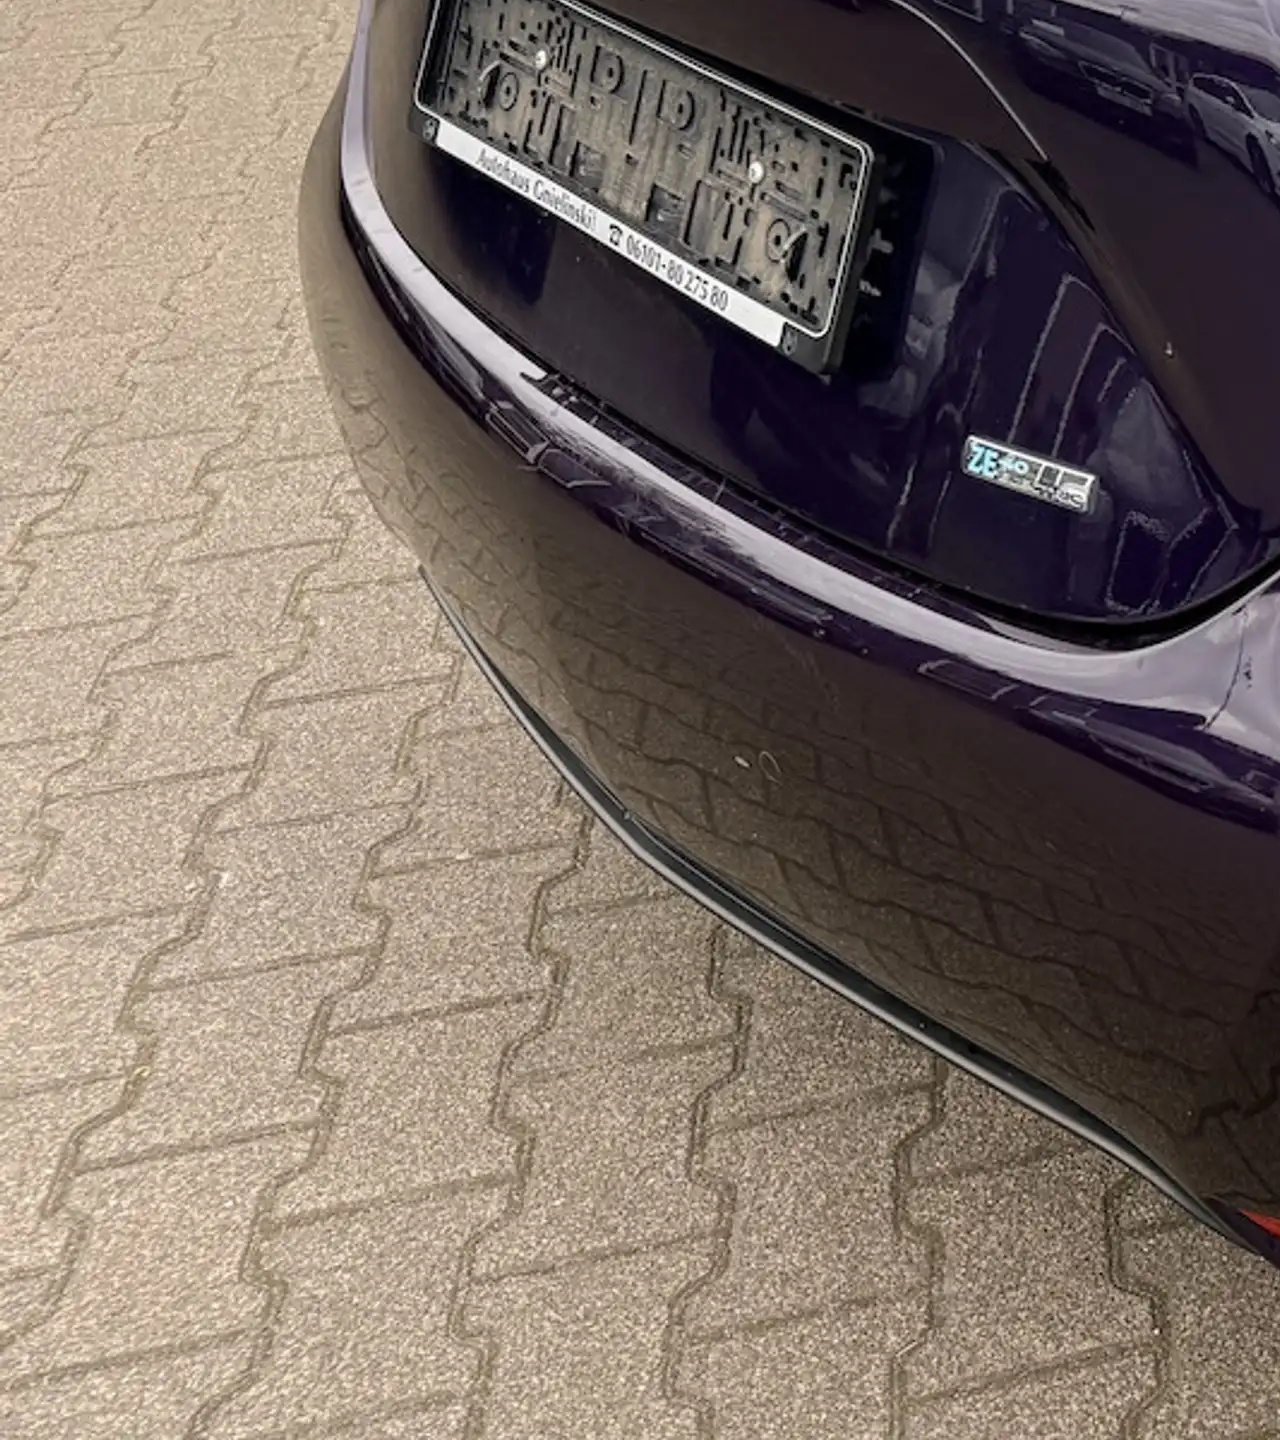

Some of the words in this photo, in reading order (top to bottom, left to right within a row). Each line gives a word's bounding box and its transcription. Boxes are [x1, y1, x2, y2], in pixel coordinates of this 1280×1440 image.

[475, 146, 531, 193] Autohaus
[684, 269, 709, 300] 275
[710, 284, 729, 311] 80
